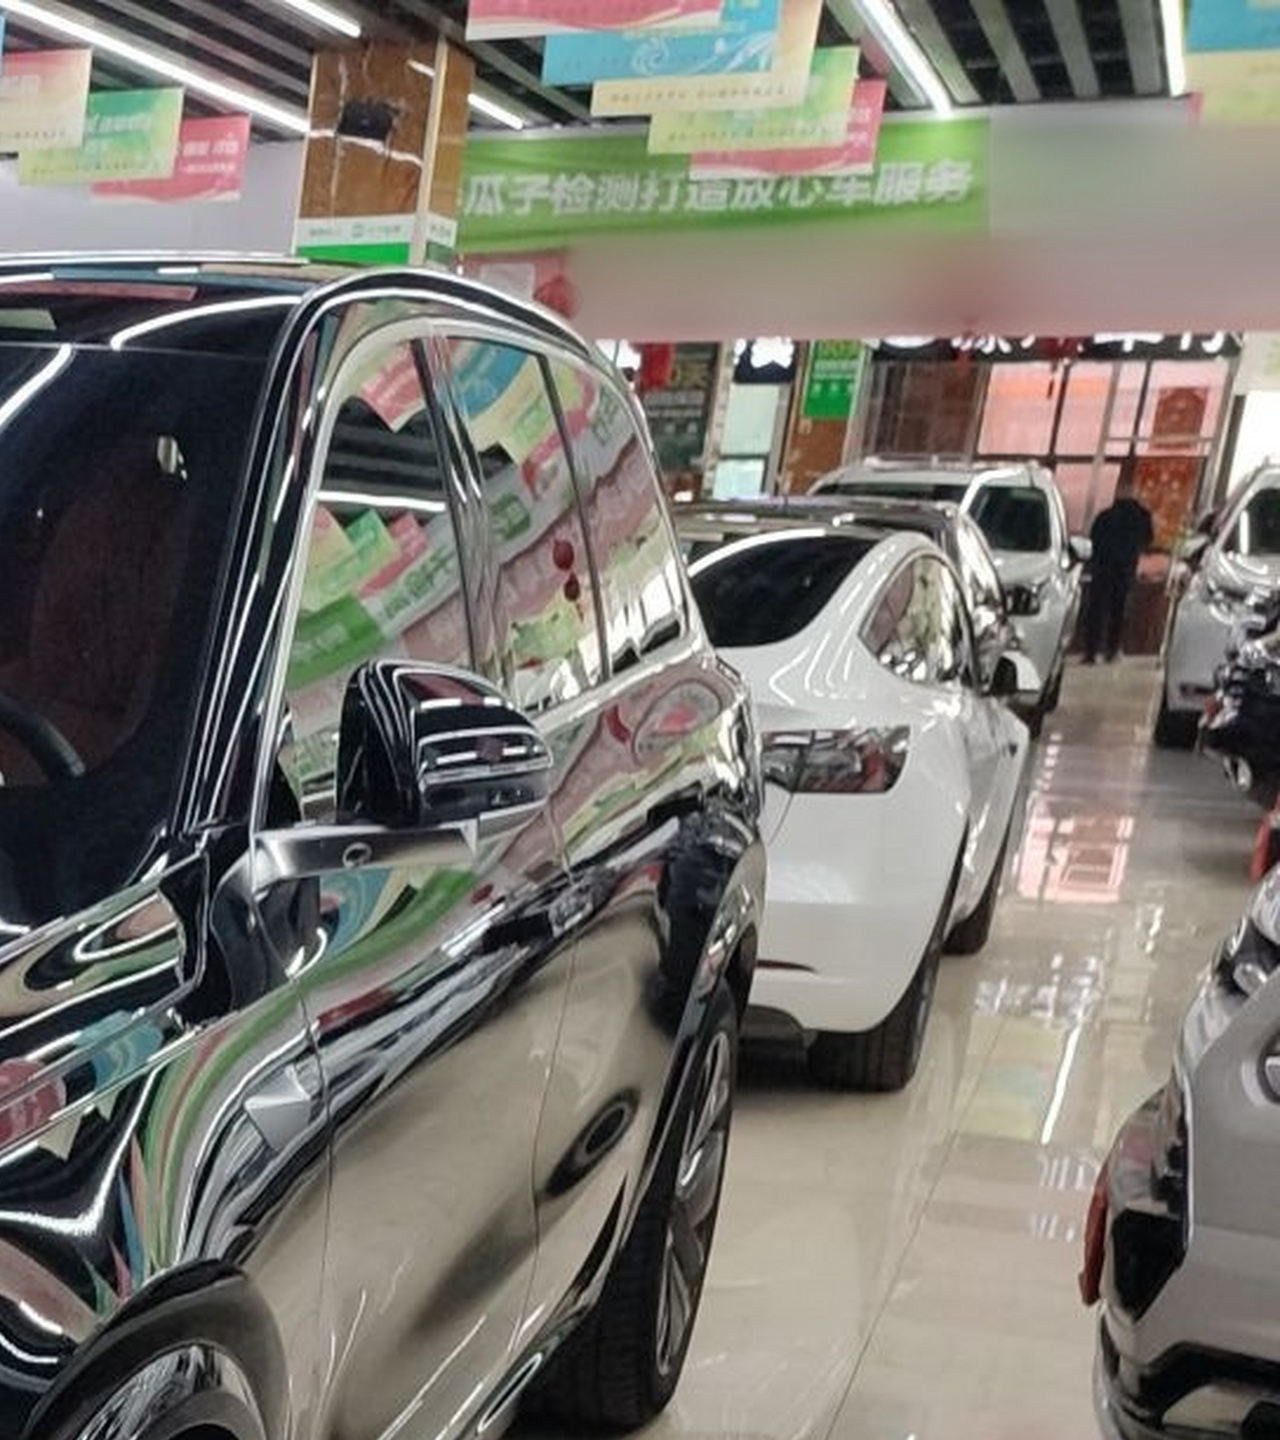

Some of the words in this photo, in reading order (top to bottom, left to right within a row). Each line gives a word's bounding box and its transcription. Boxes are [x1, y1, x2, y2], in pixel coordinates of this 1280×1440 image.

[465, 160, 972, 216] 瓜子检测打造放心车服务
